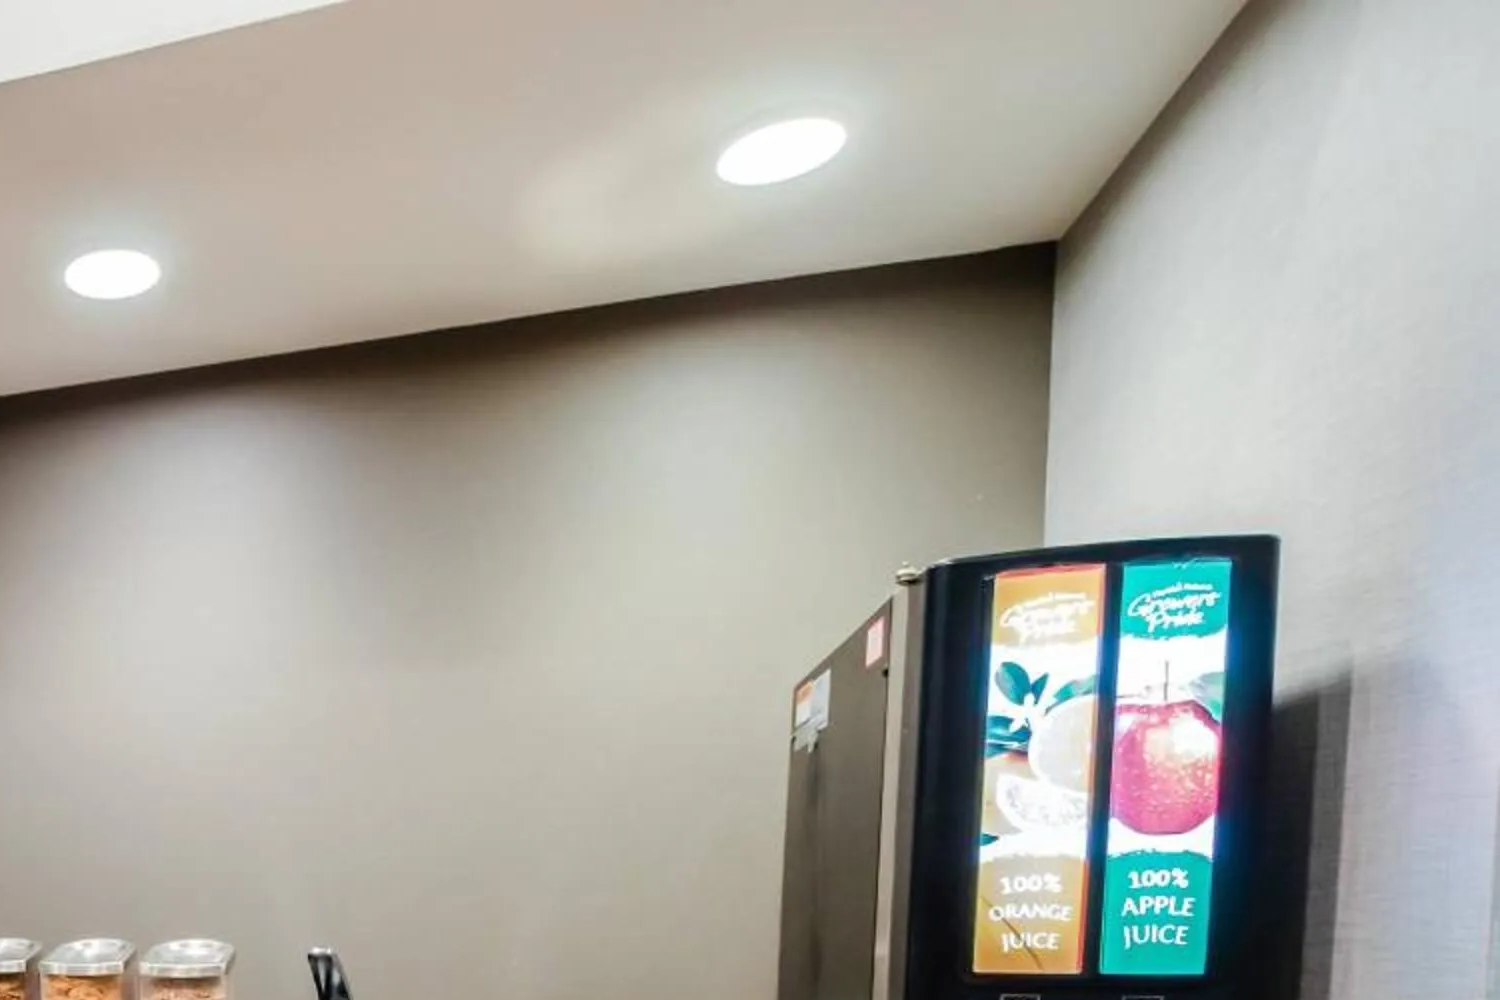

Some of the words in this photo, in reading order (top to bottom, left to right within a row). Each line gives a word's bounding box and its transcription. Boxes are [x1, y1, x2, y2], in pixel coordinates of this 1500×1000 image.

[1000, 872, 1063, 895] 100%
[1127, 867, 1189, 889] 100%
[988, 902, 1073, 922] ORANGE
[1121, 895, 1196, 917] APPLE
[1001, 931, 1060, 952] JUICE
[1123, 924, 1189, 949] JUICE
